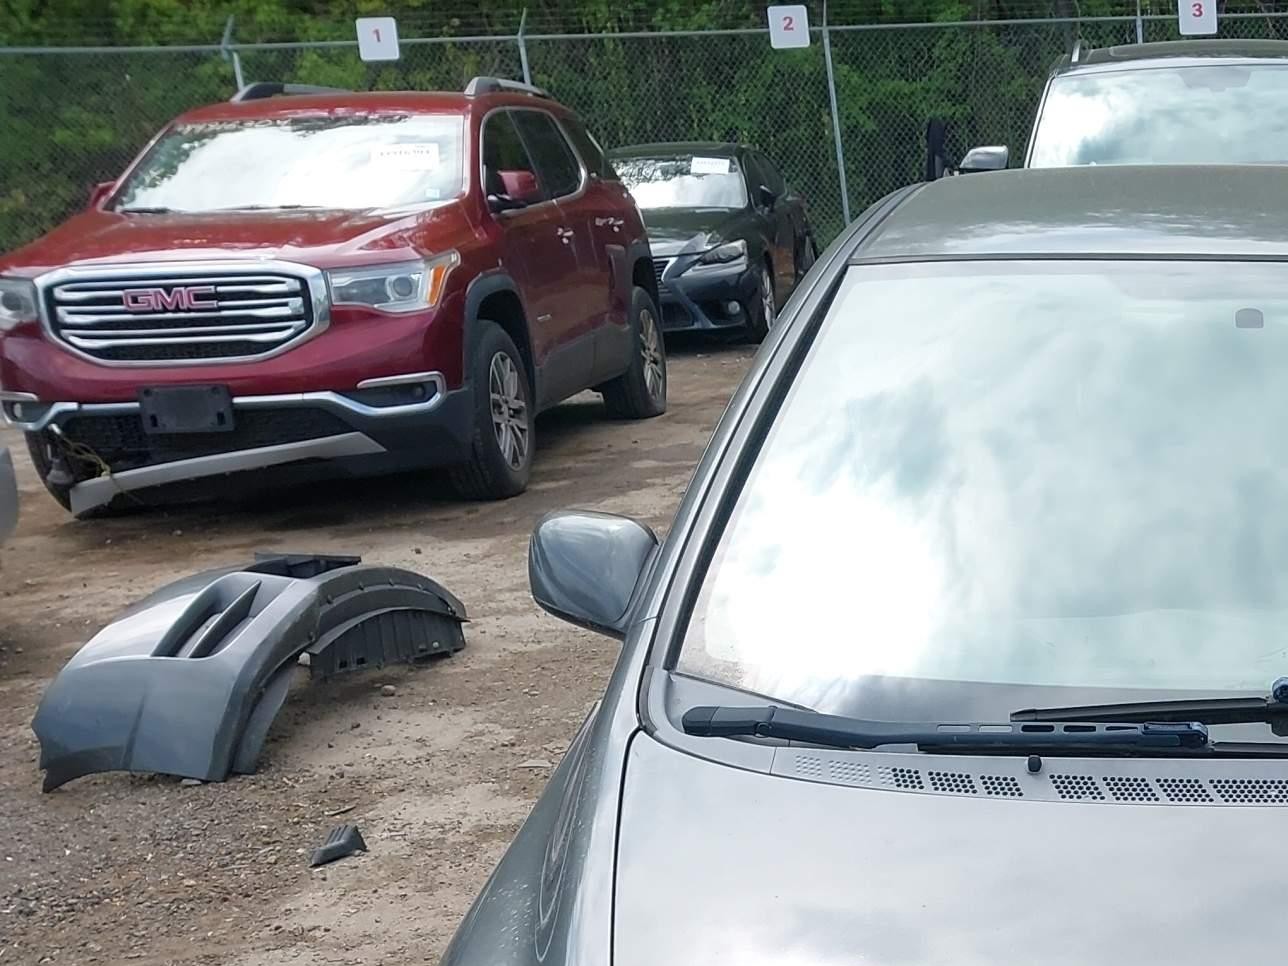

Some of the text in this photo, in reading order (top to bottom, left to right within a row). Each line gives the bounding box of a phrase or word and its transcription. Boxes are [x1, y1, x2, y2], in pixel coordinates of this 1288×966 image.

[1192, 2, 1204, 18] 3
[782, 15, 795, 31] 2
[372, 28, 382, 43] 1
[121, 285, 219, 311] GMC
